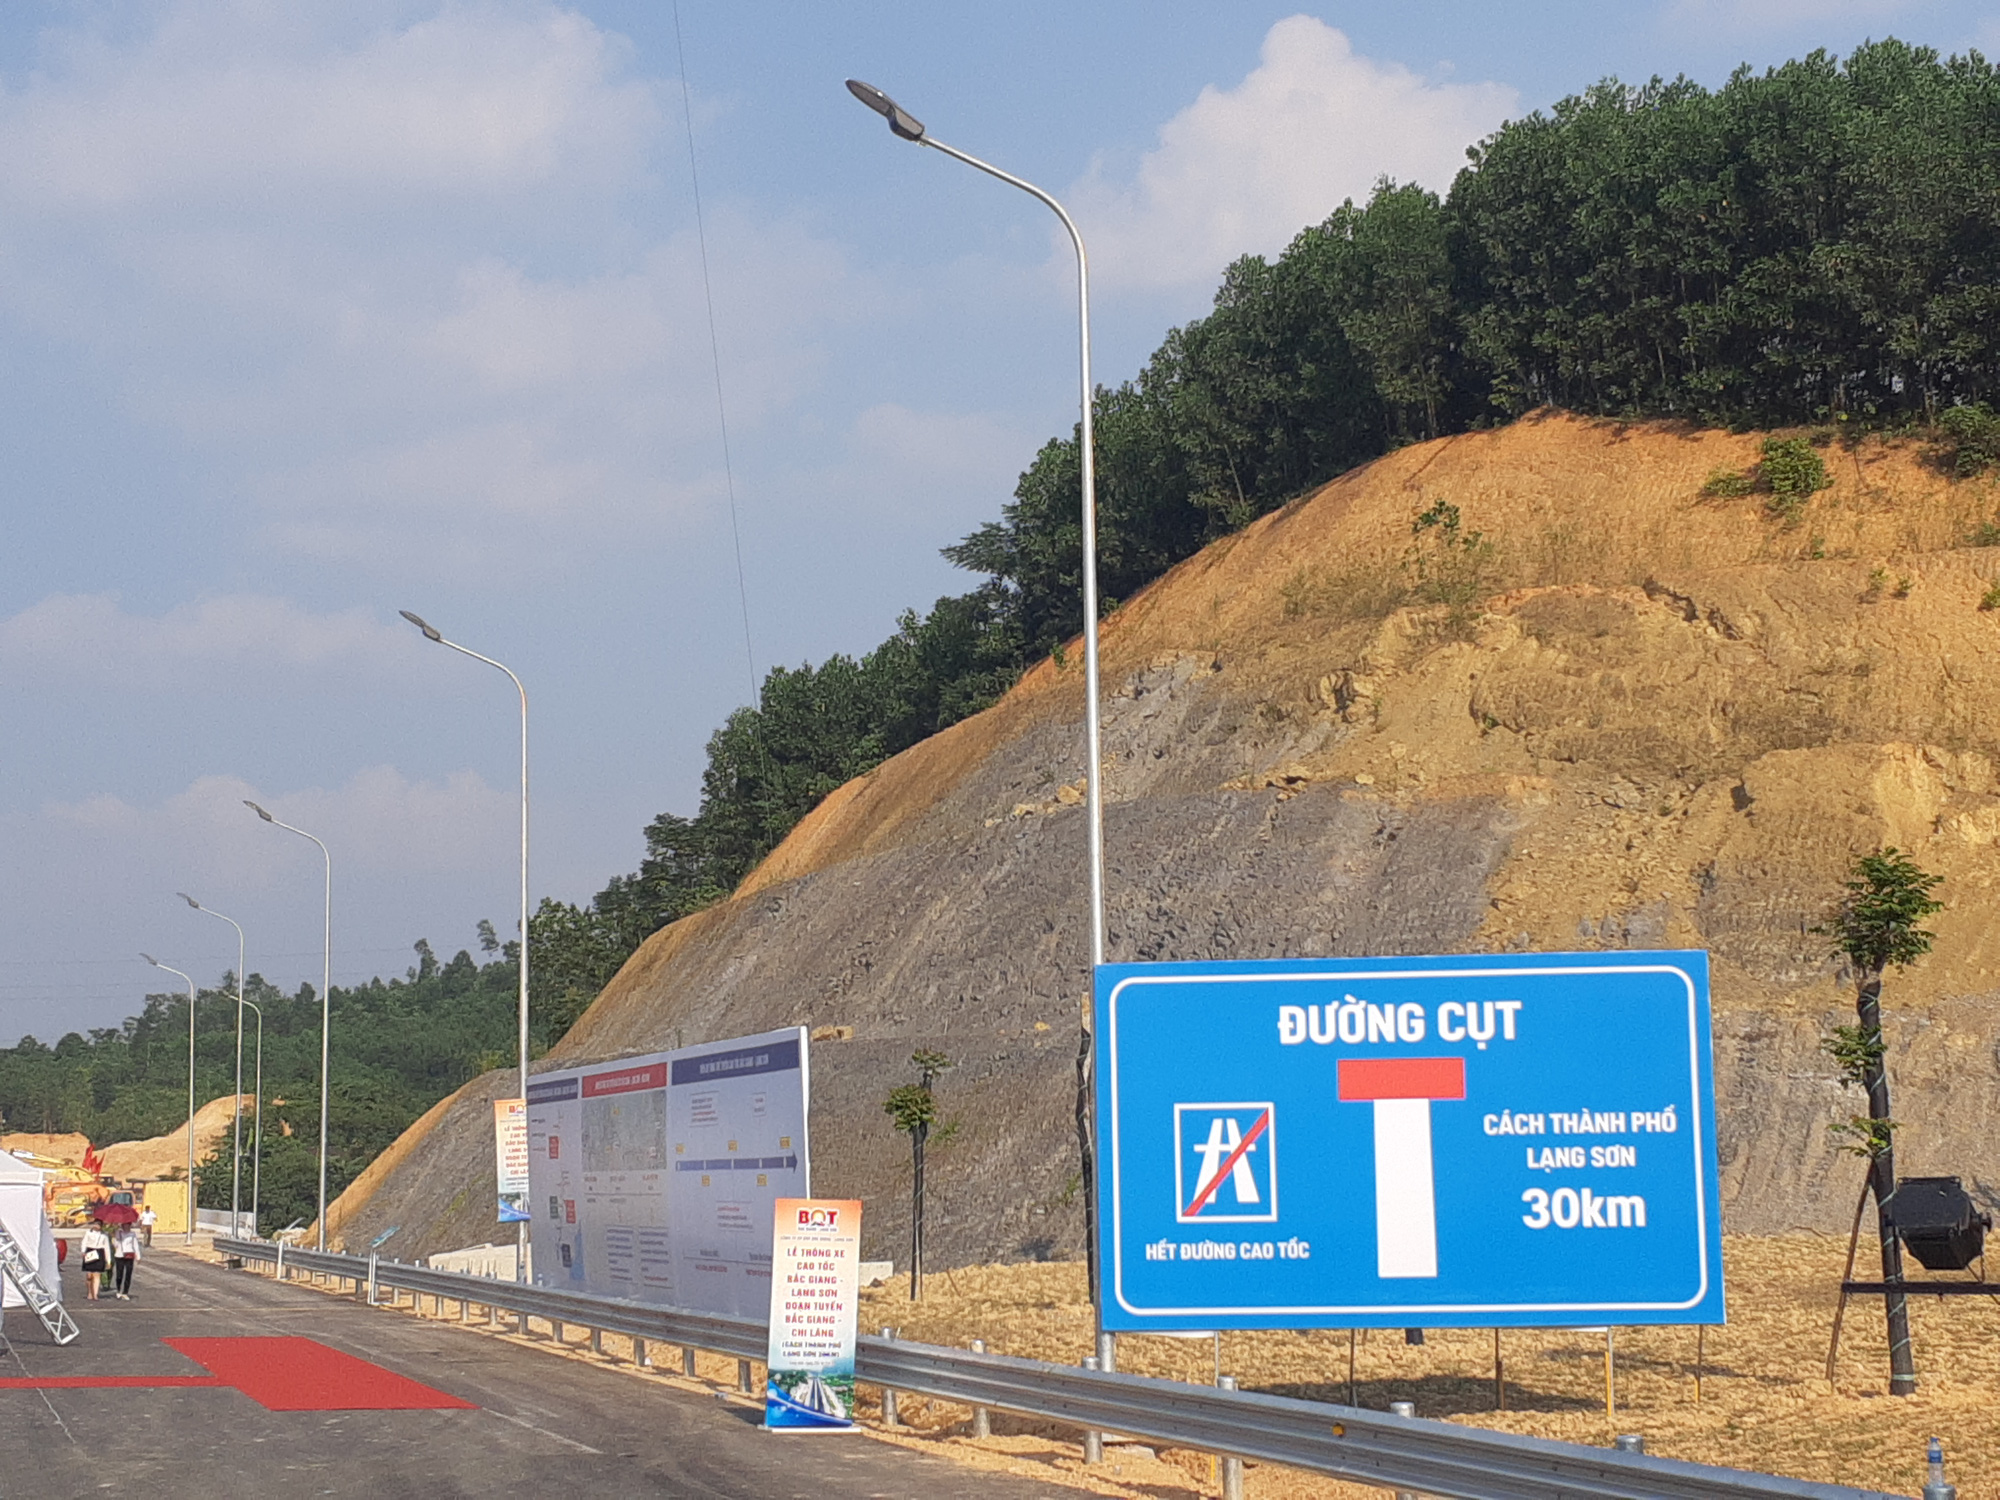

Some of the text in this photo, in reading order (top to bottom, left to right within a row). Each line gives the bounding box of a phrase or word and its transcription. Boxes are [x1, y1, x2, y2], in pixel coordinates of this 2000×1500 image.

[1277, 993, 1522, 1050] ĐƯỜNG CỤT
[1483, 1103, 1678, 1136] CÁCH THÀNH PHỐ
[1526, 1144, 1637, 1173] LẠNG SƠN
[1521, 1188, 1647, 1229] 30km
[798, 1210, 838, 1226] BOT
[834, 1249, 845, 1258] XE
[1145, 1236, 1310, 1261] HẾT ĐƯỜNG CAO TỐC
[797, 1262, 815, 1271] CAO
[808, 1275, 837, 1285] GIANG
[818, 1289, 838, 1298] SƠN
[807, 1315, 835, 1324] GIANG
[791, 1328, 807, 1337] CHI
